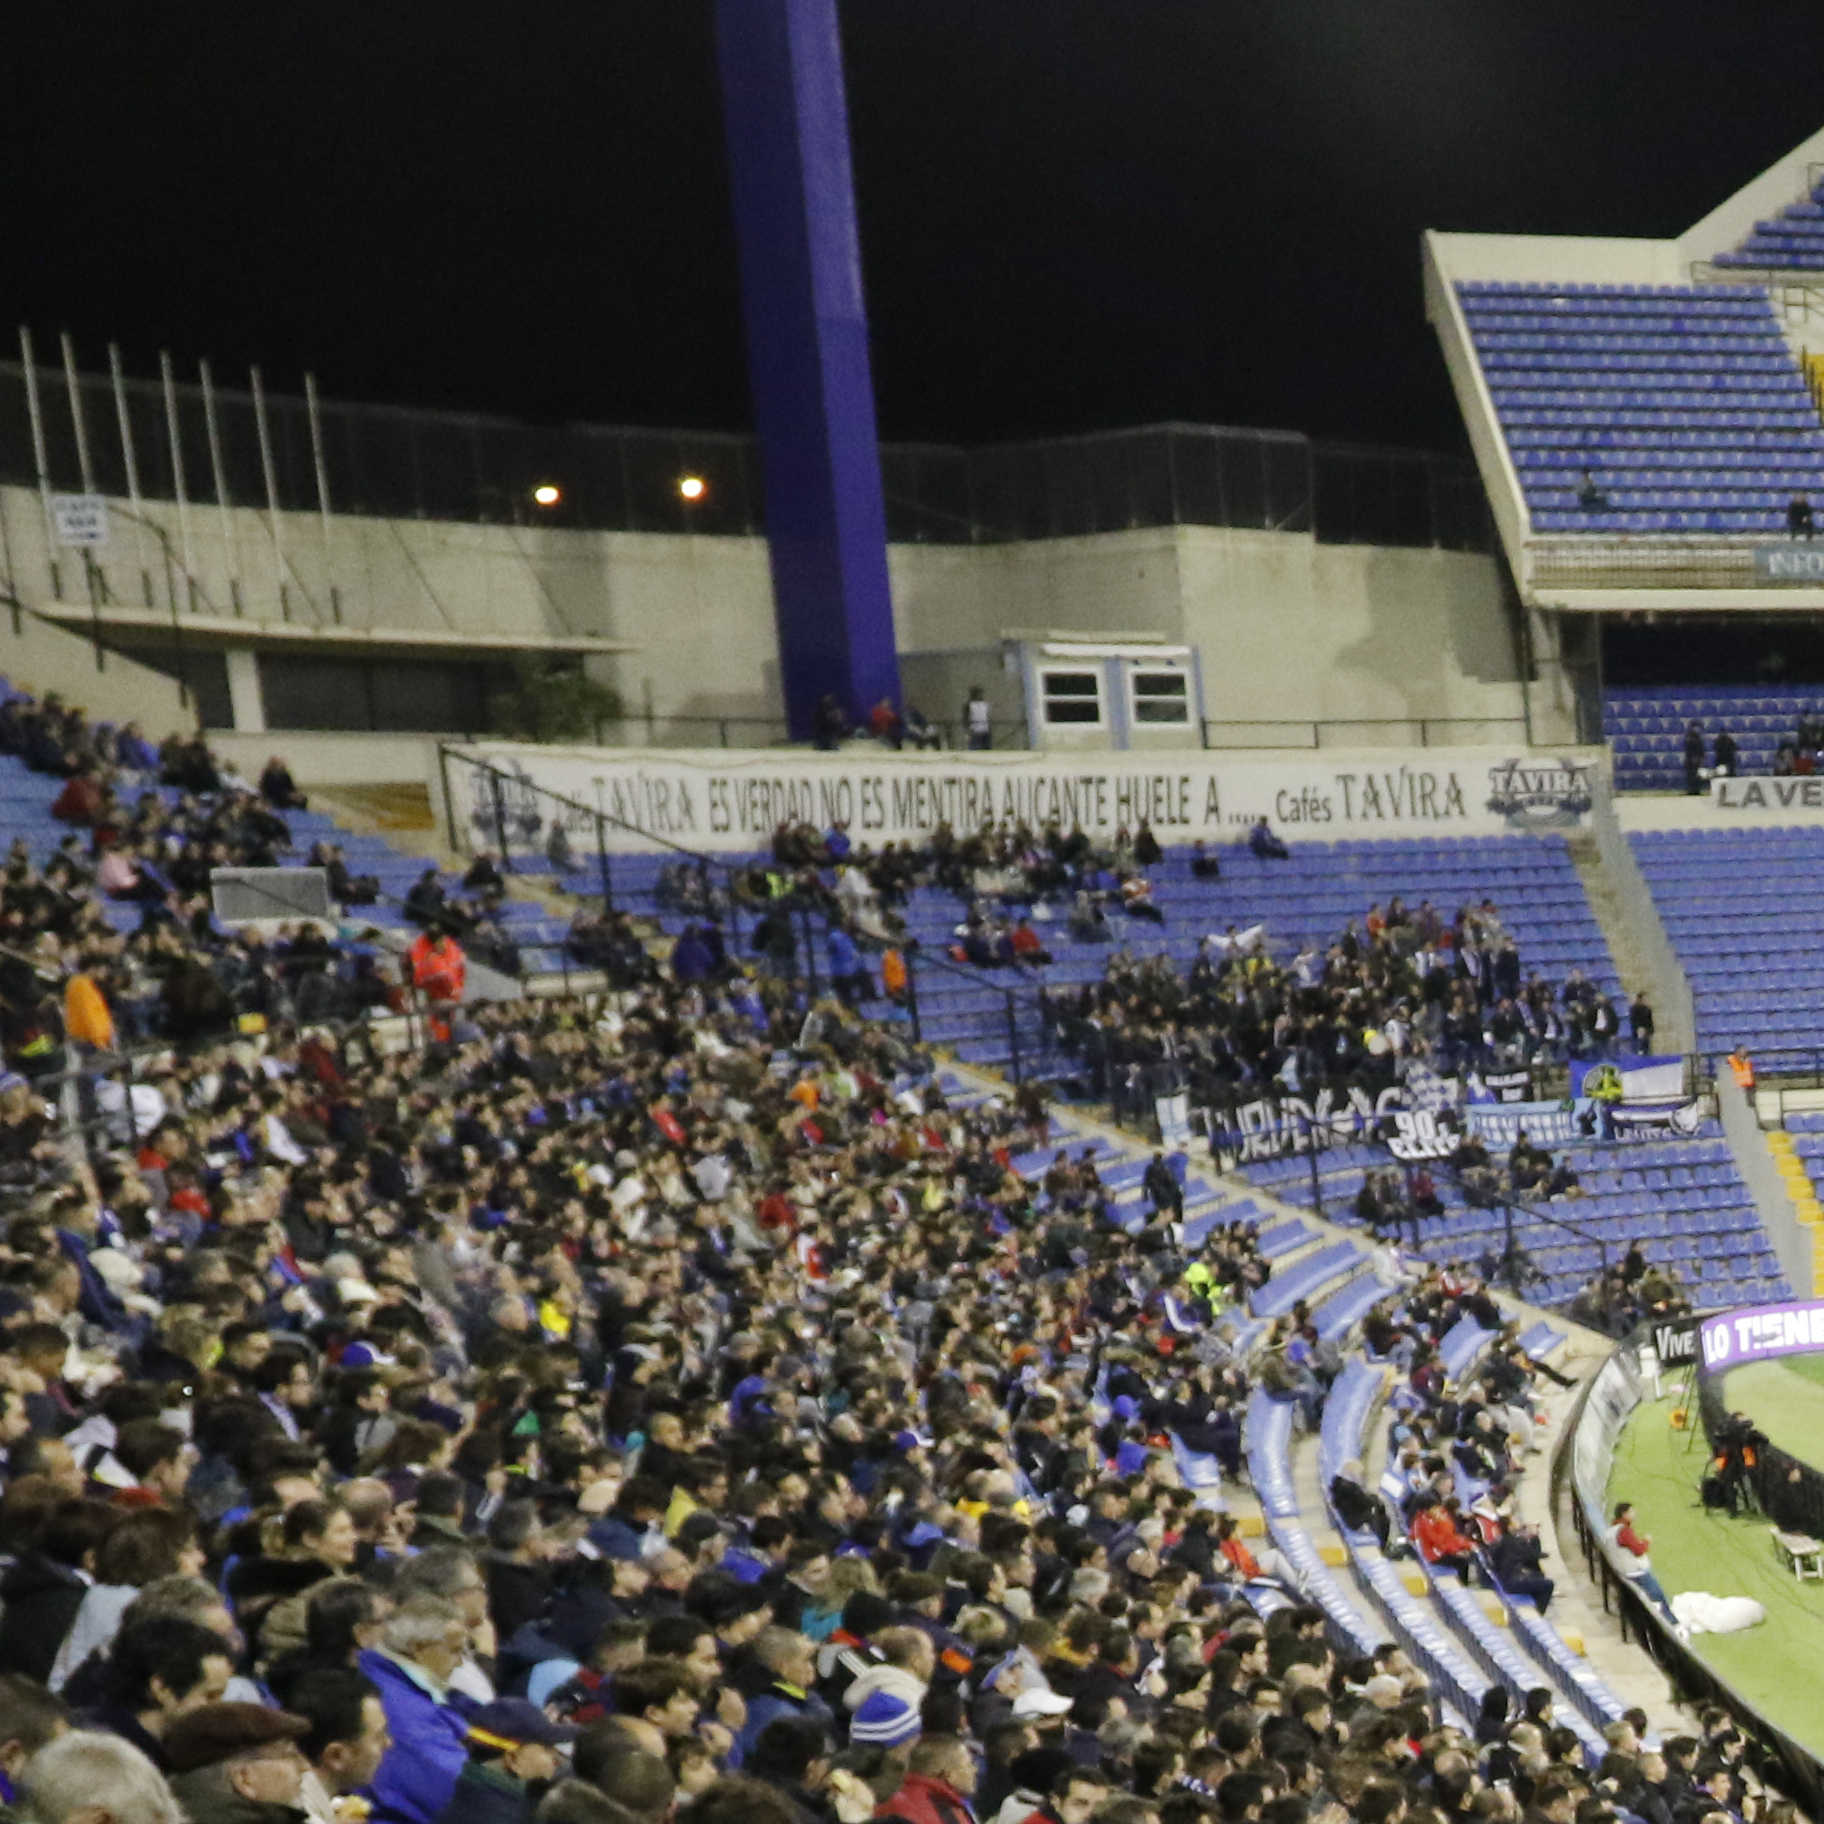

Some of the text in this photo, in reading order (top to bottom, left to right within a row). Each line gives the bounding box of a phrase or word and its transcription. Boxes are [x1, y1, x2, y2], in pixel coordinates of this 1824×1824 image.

[709, 777, 730, 832] ES
[735, 776, 813, 832] VERDAD
[860, 777, 886, 830] ES
[892, 775, 995, 830] MENTIRA
[1115, 775, 1191, 826] HUELE
[1275, 786, 1333, 823] Cafés
[1717, 780, 1768, 808] LA
[1703, 1322, 1730, 1367] LO
